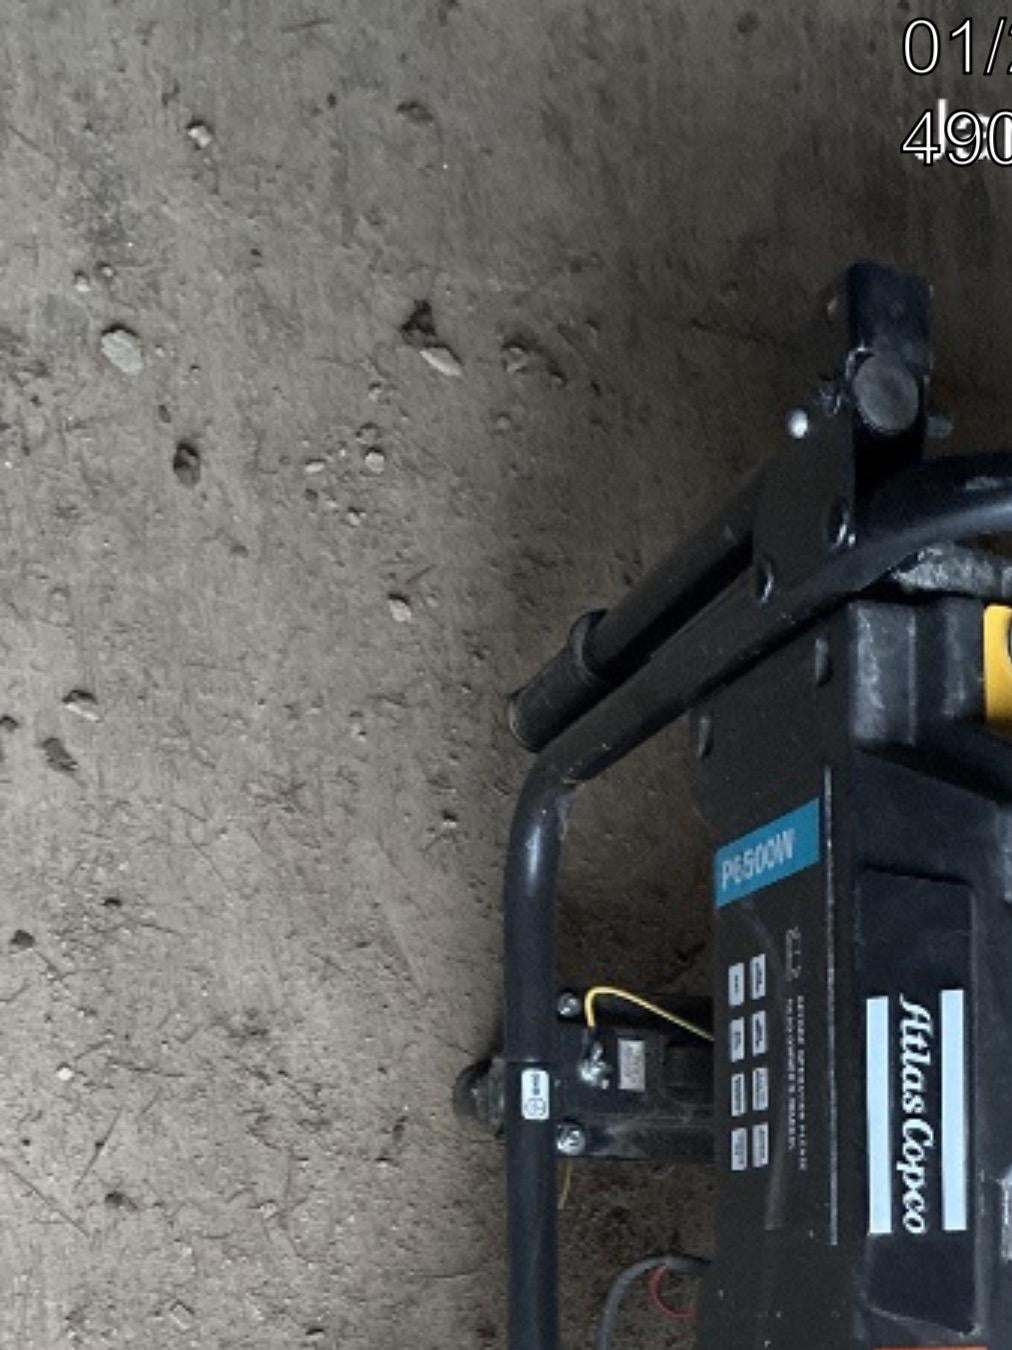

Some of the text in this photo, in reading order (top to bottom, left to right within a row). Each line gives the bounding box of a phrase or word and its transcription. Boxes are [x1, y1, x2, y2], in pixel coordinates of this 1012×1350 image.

[721, 827, 796, 893] P6500W
[896, 993, 935, 1236] Atlas Copco
